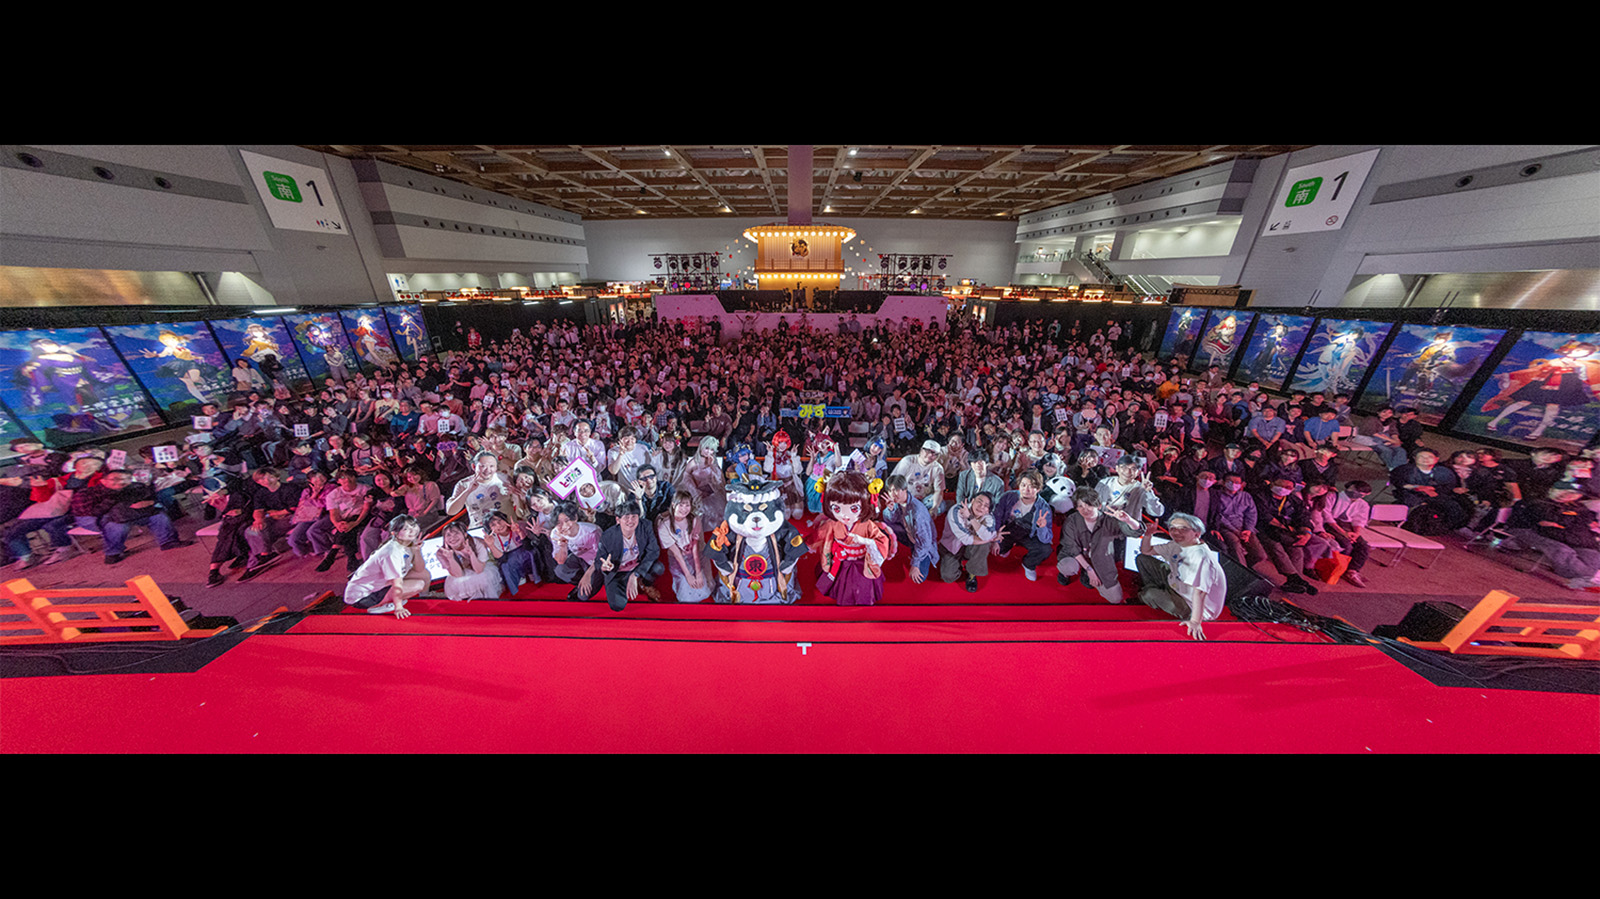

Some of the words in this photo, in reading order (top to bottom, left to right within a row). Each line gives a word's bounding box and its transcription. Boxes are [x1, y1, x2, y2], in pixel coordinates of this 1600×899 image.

[275, 183, 295, 200] 南
[306, 180, 324, 207] 1
[1292, 189, 1311, 205] 南
[1331, 170, 1350, 201] 1
